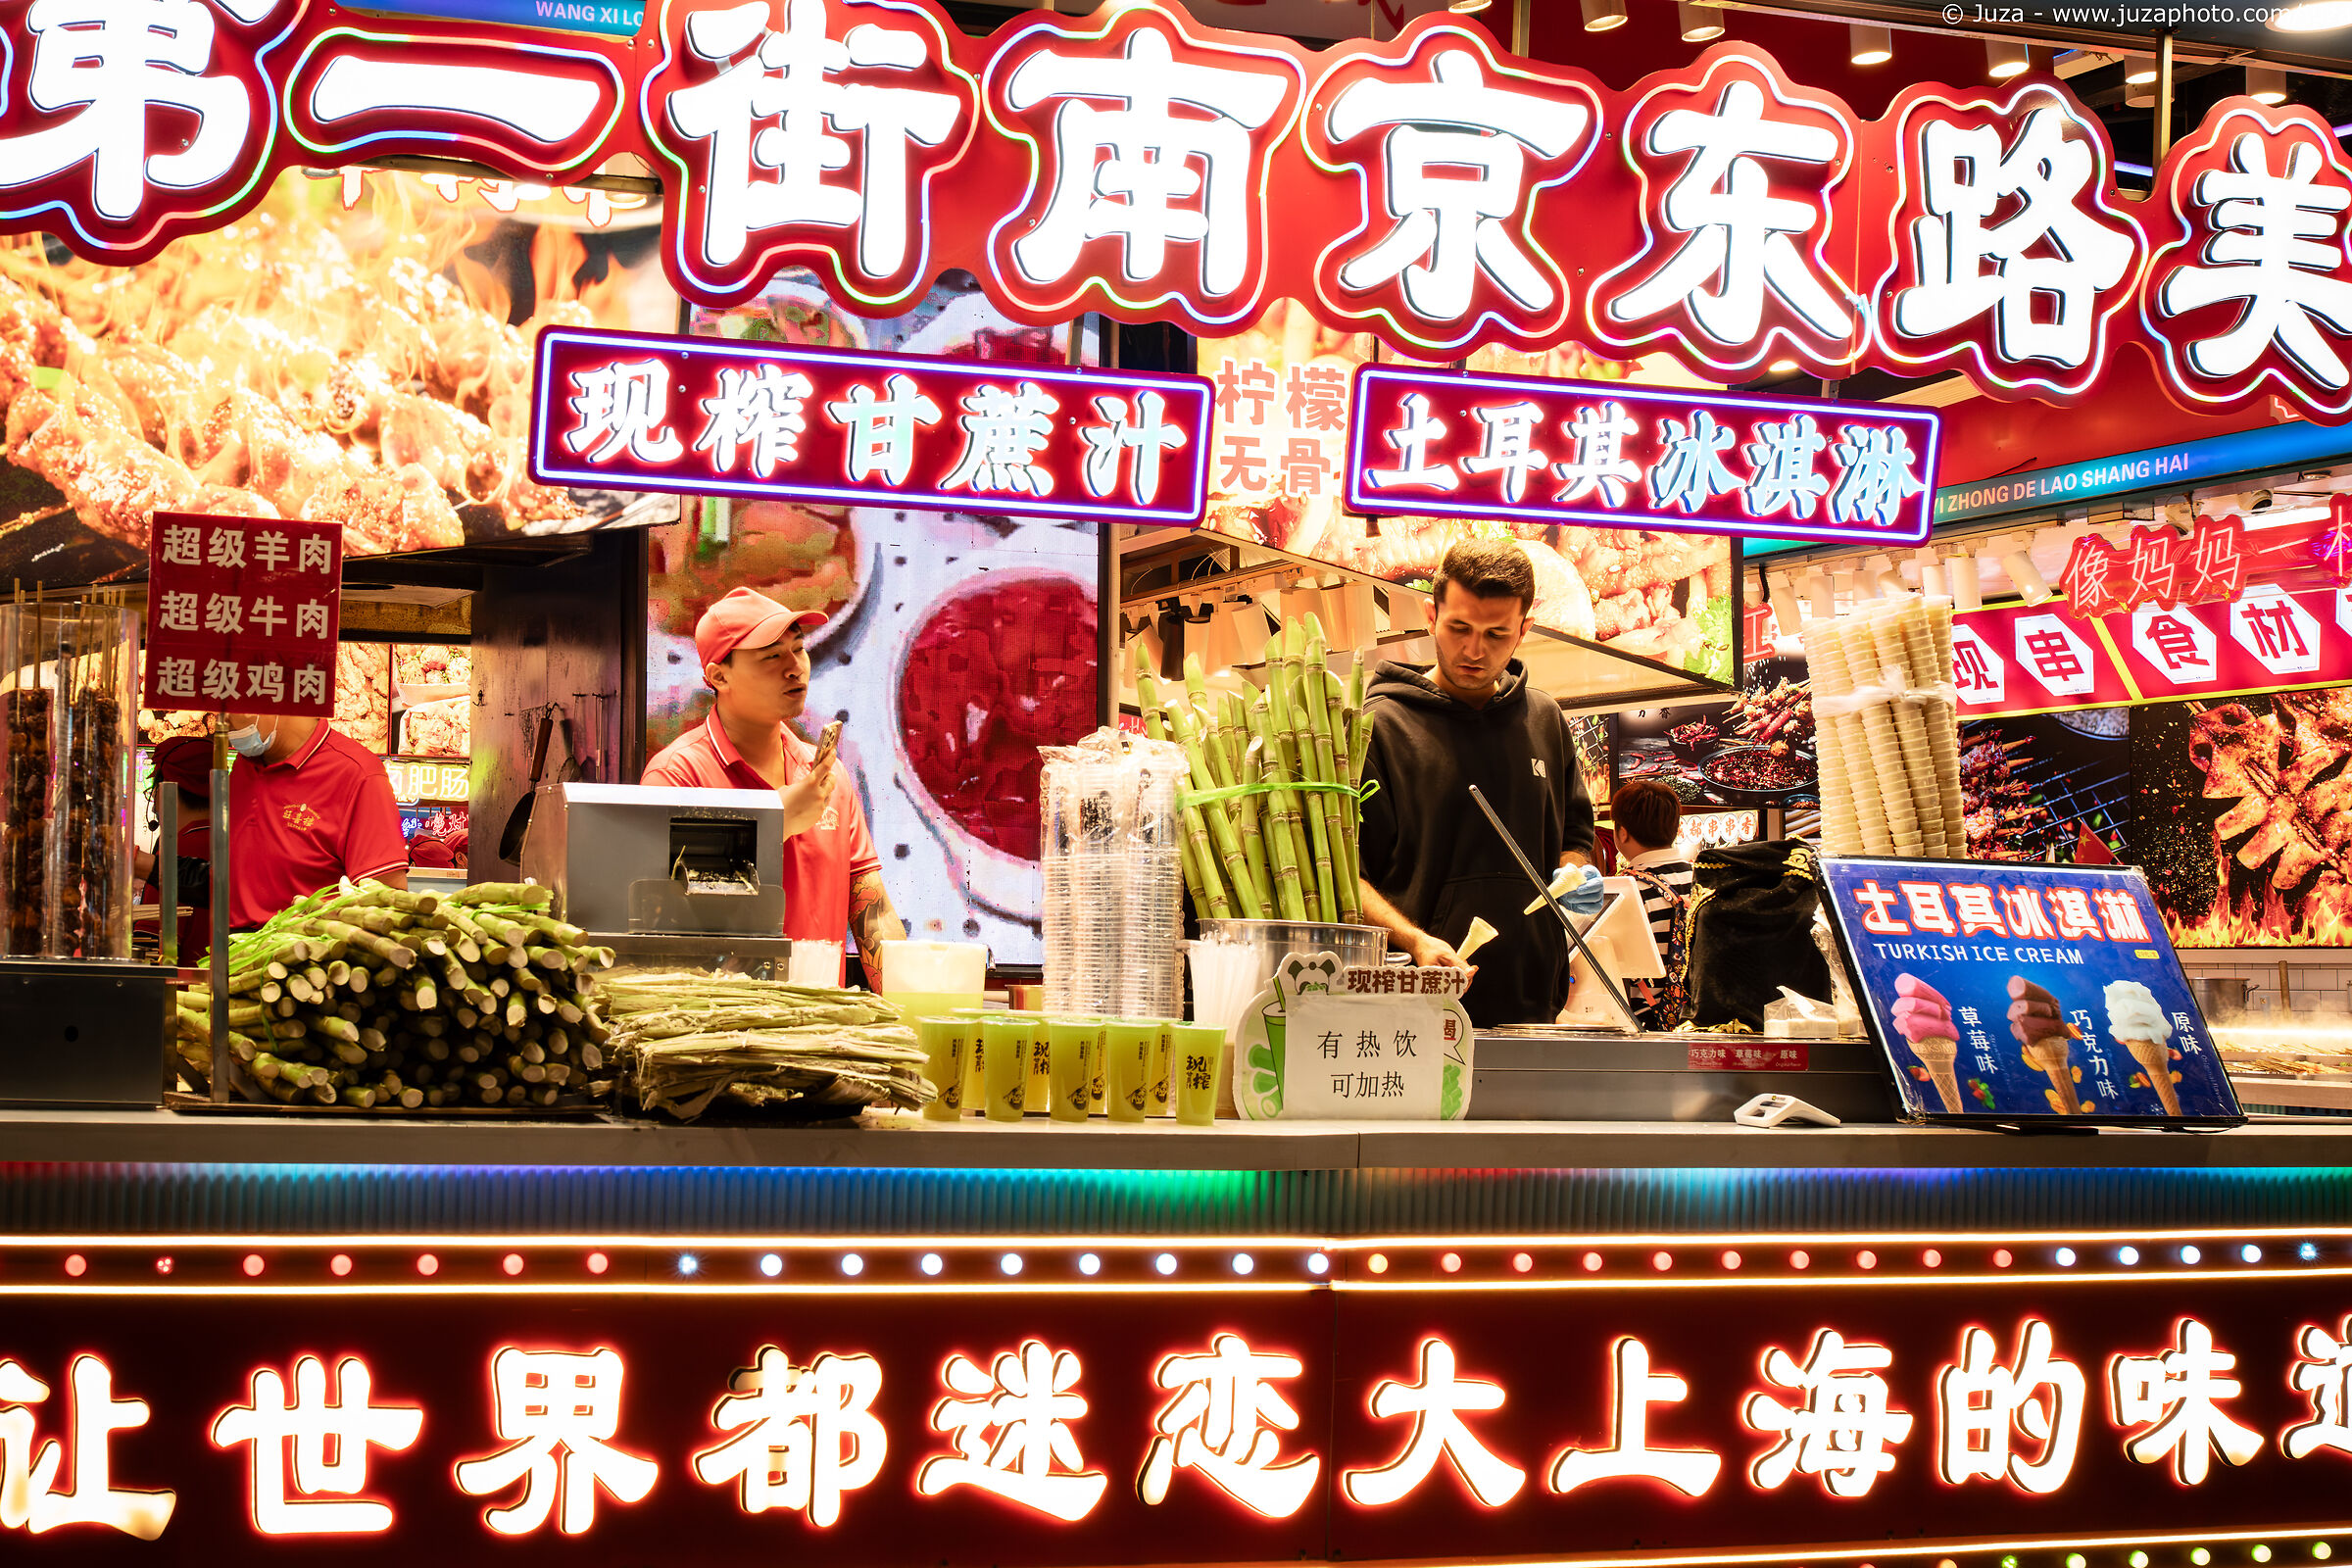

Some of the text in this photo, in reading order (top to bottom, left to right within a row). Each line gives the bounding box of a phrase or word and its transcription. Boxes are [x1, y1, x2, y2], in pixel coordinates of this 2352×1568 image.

[535, 0, 595, 22] WANG
[600, 7, 617, 24] XI
[1215, 361, 1346, 431] 柠檬
[564, 358, 1186, 506] 现榨甘蔗汁
[1220, 436, 1330, 494] 无骨
[1364, 393, 1927, 526] 土耳其冰淇淋
[1948, 486, 2008, 512] ZHONG
[2013, 480, 2035, 500] DE
[2041, 473, 2077, 496] LAO
[2082, 460, 2149, 487] SHANG
[2155, 453, 2188, 475] HAI
[162, 524, 331, 574] 超级羊肉
[159, 590, 329, 639] 超级牛肉
[157, 657, 326, 705] 超级鸡肉
[1853, 879, 2152, 943] 土耳其冰淇淋
[1873, 943, 2084, 964] TURKISH ICE CREAM
[1348, 969, 1465, 995] 现榨甘蔗汁
[1780, 1050, 1797, 1059] 原味
[1958, 1007, 1998, 1075] 草莓味
[2070, 1009, 2119, 1100] 巧克力味
[2171, 1011, 2202, 1055] 原味
[1330, 1071, 1404, 1099] 可加热
